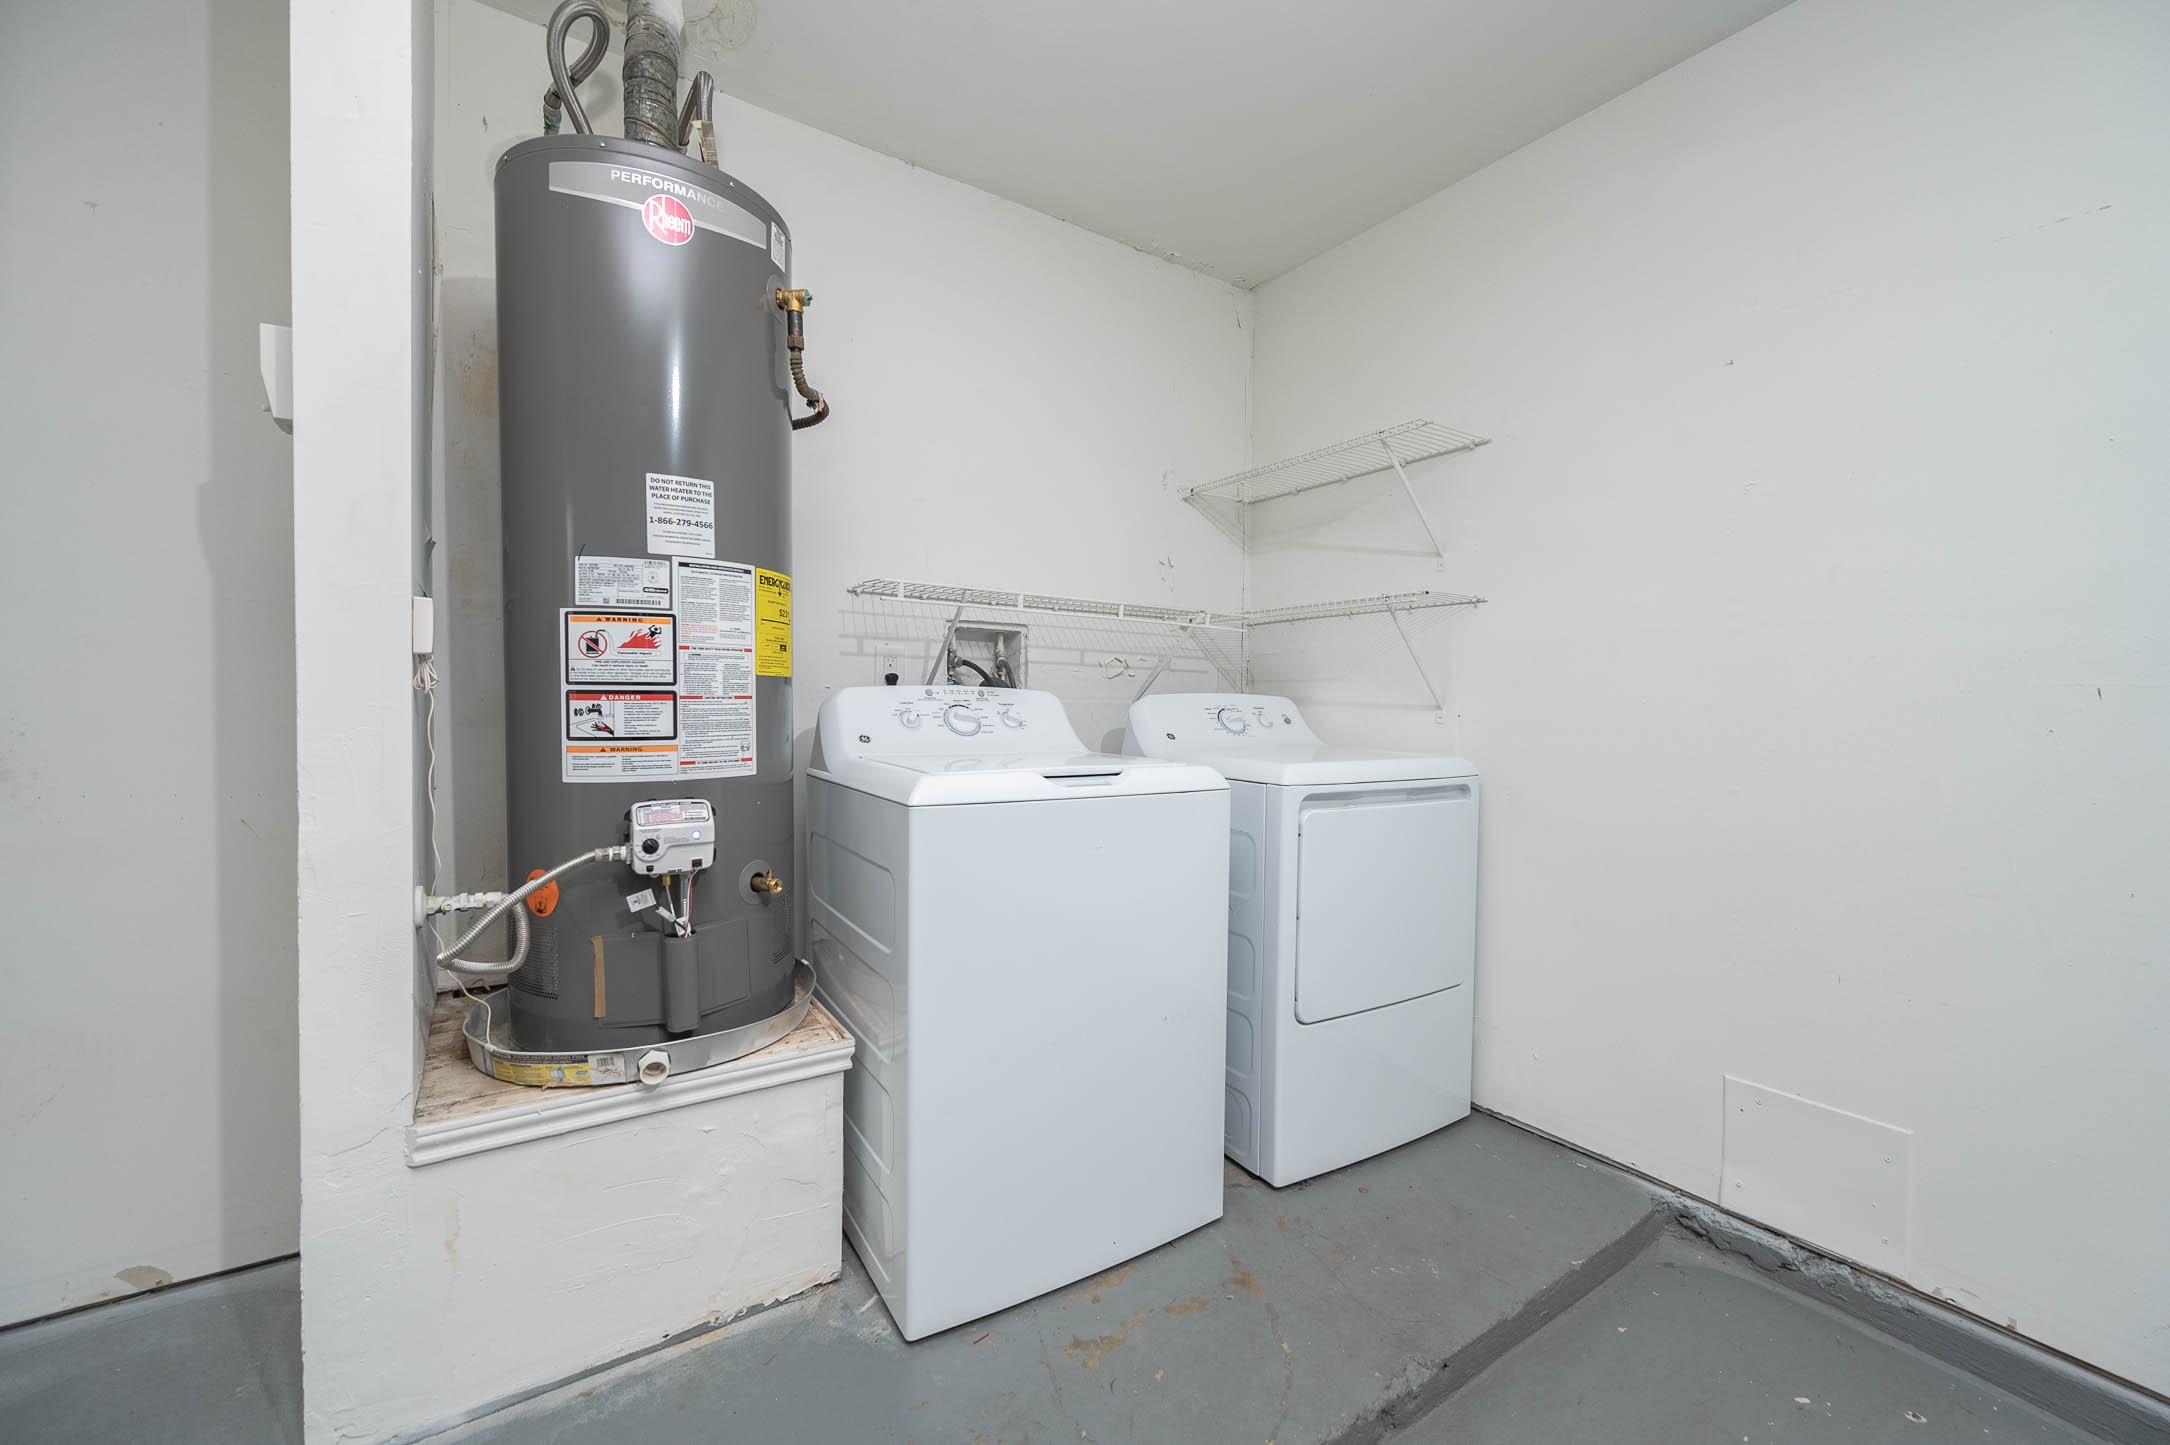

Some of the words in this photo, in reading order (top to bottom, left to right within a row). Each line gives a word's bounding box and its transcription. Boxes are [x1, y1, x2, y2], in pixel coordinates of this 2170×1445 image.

[611, 169, 727, 212] PERFORMANCE
[648, 195, 692, 239] Rheem
[675, 480, 698, 488] RETURN
[671, 487, 693, 495] HEATER
[651, 492, 670, 500] PLACE
[681, 495, 711, 505] PURCHASE
[649, 516, 714, 530] 1-866-279-4566
